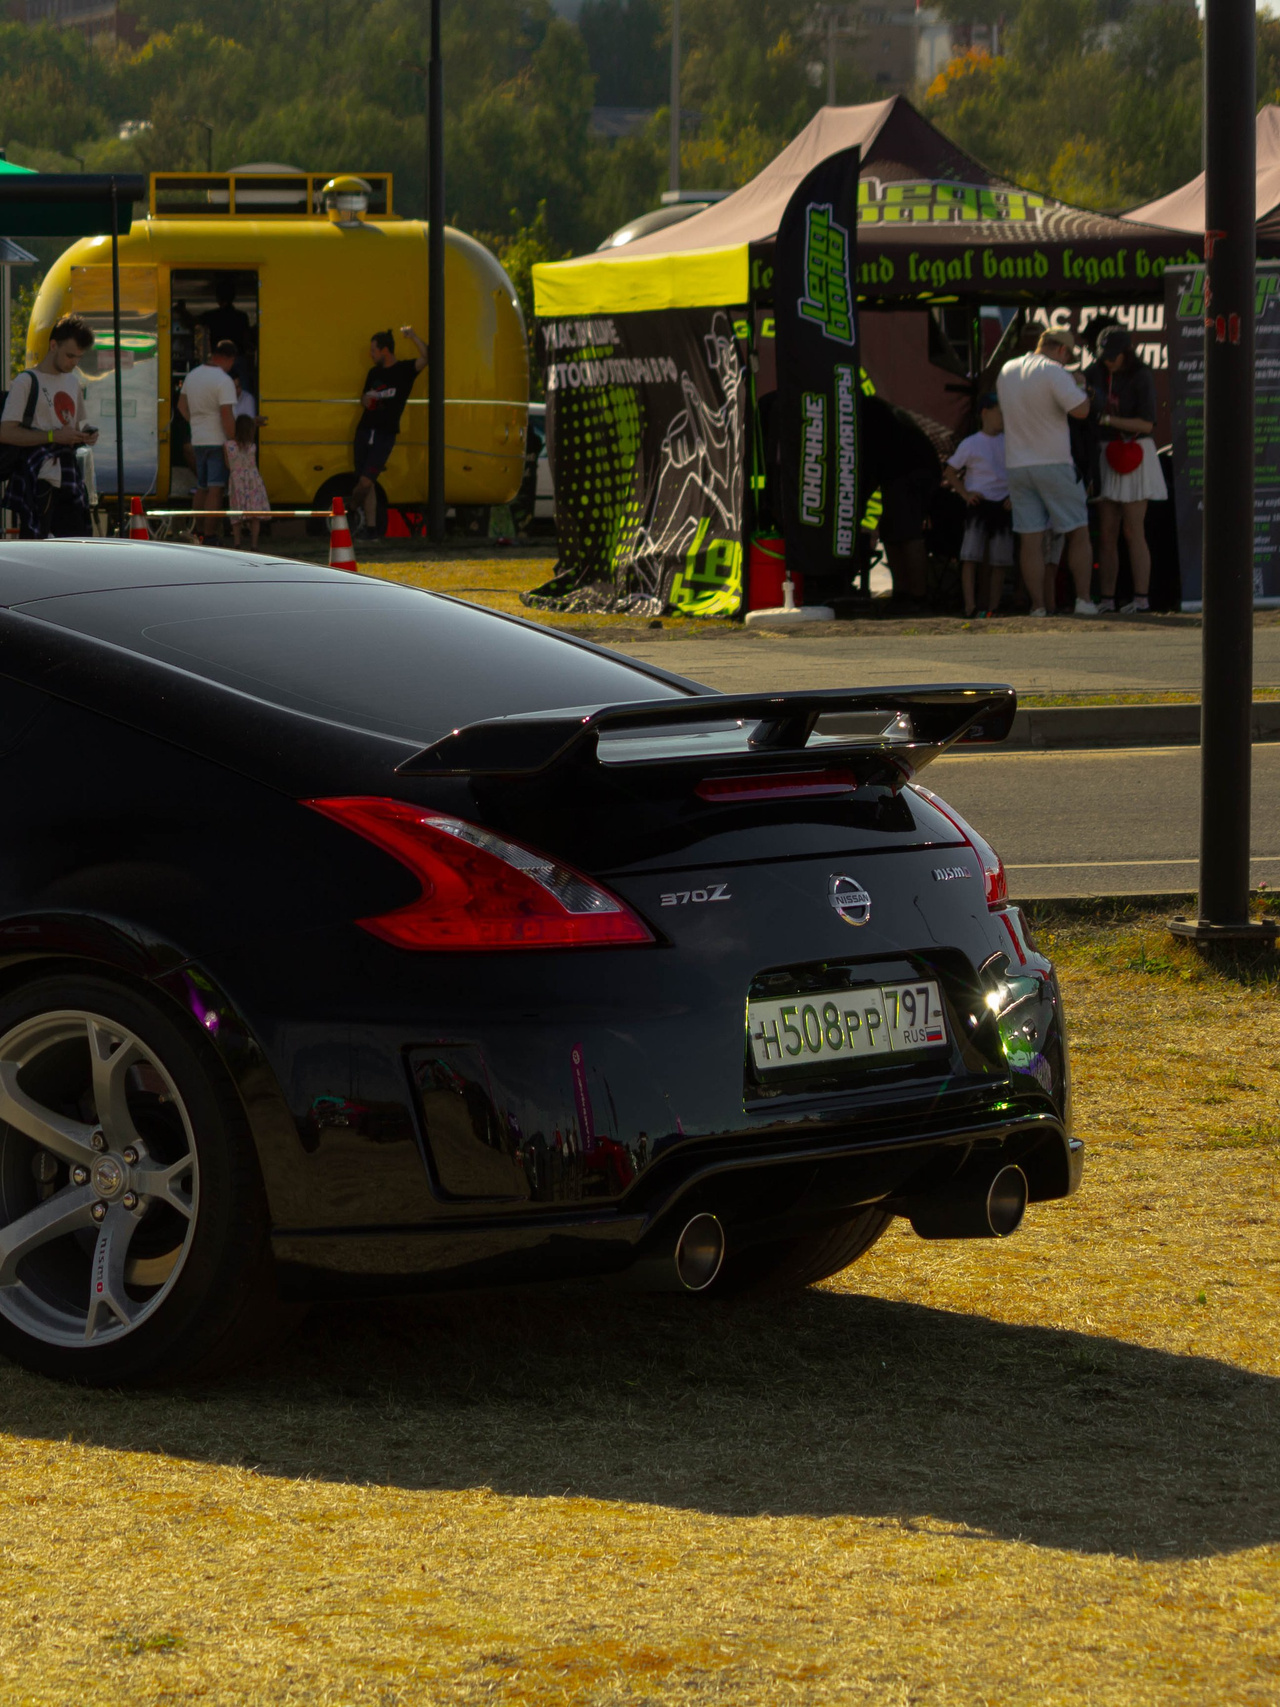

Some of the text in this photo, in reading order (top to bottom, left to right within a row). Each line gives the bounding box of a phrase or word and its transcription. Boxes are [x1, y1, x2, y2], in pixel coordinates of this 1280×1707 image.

[909, 251, 974, 287] legal
[982, 249, 1050, 279] band
[1063, 249, 1128, 286] legal
[801, 395, 824, 524] ГОНОЧНЫЕ
[836, 366, 855, 556] АВТОСИМУЛЯТОРЫ
[660, 883, 732, 907] 370Z
[836, 894, 869, 905] NISSAN
[904, 1029, 926, 1044] RUS
